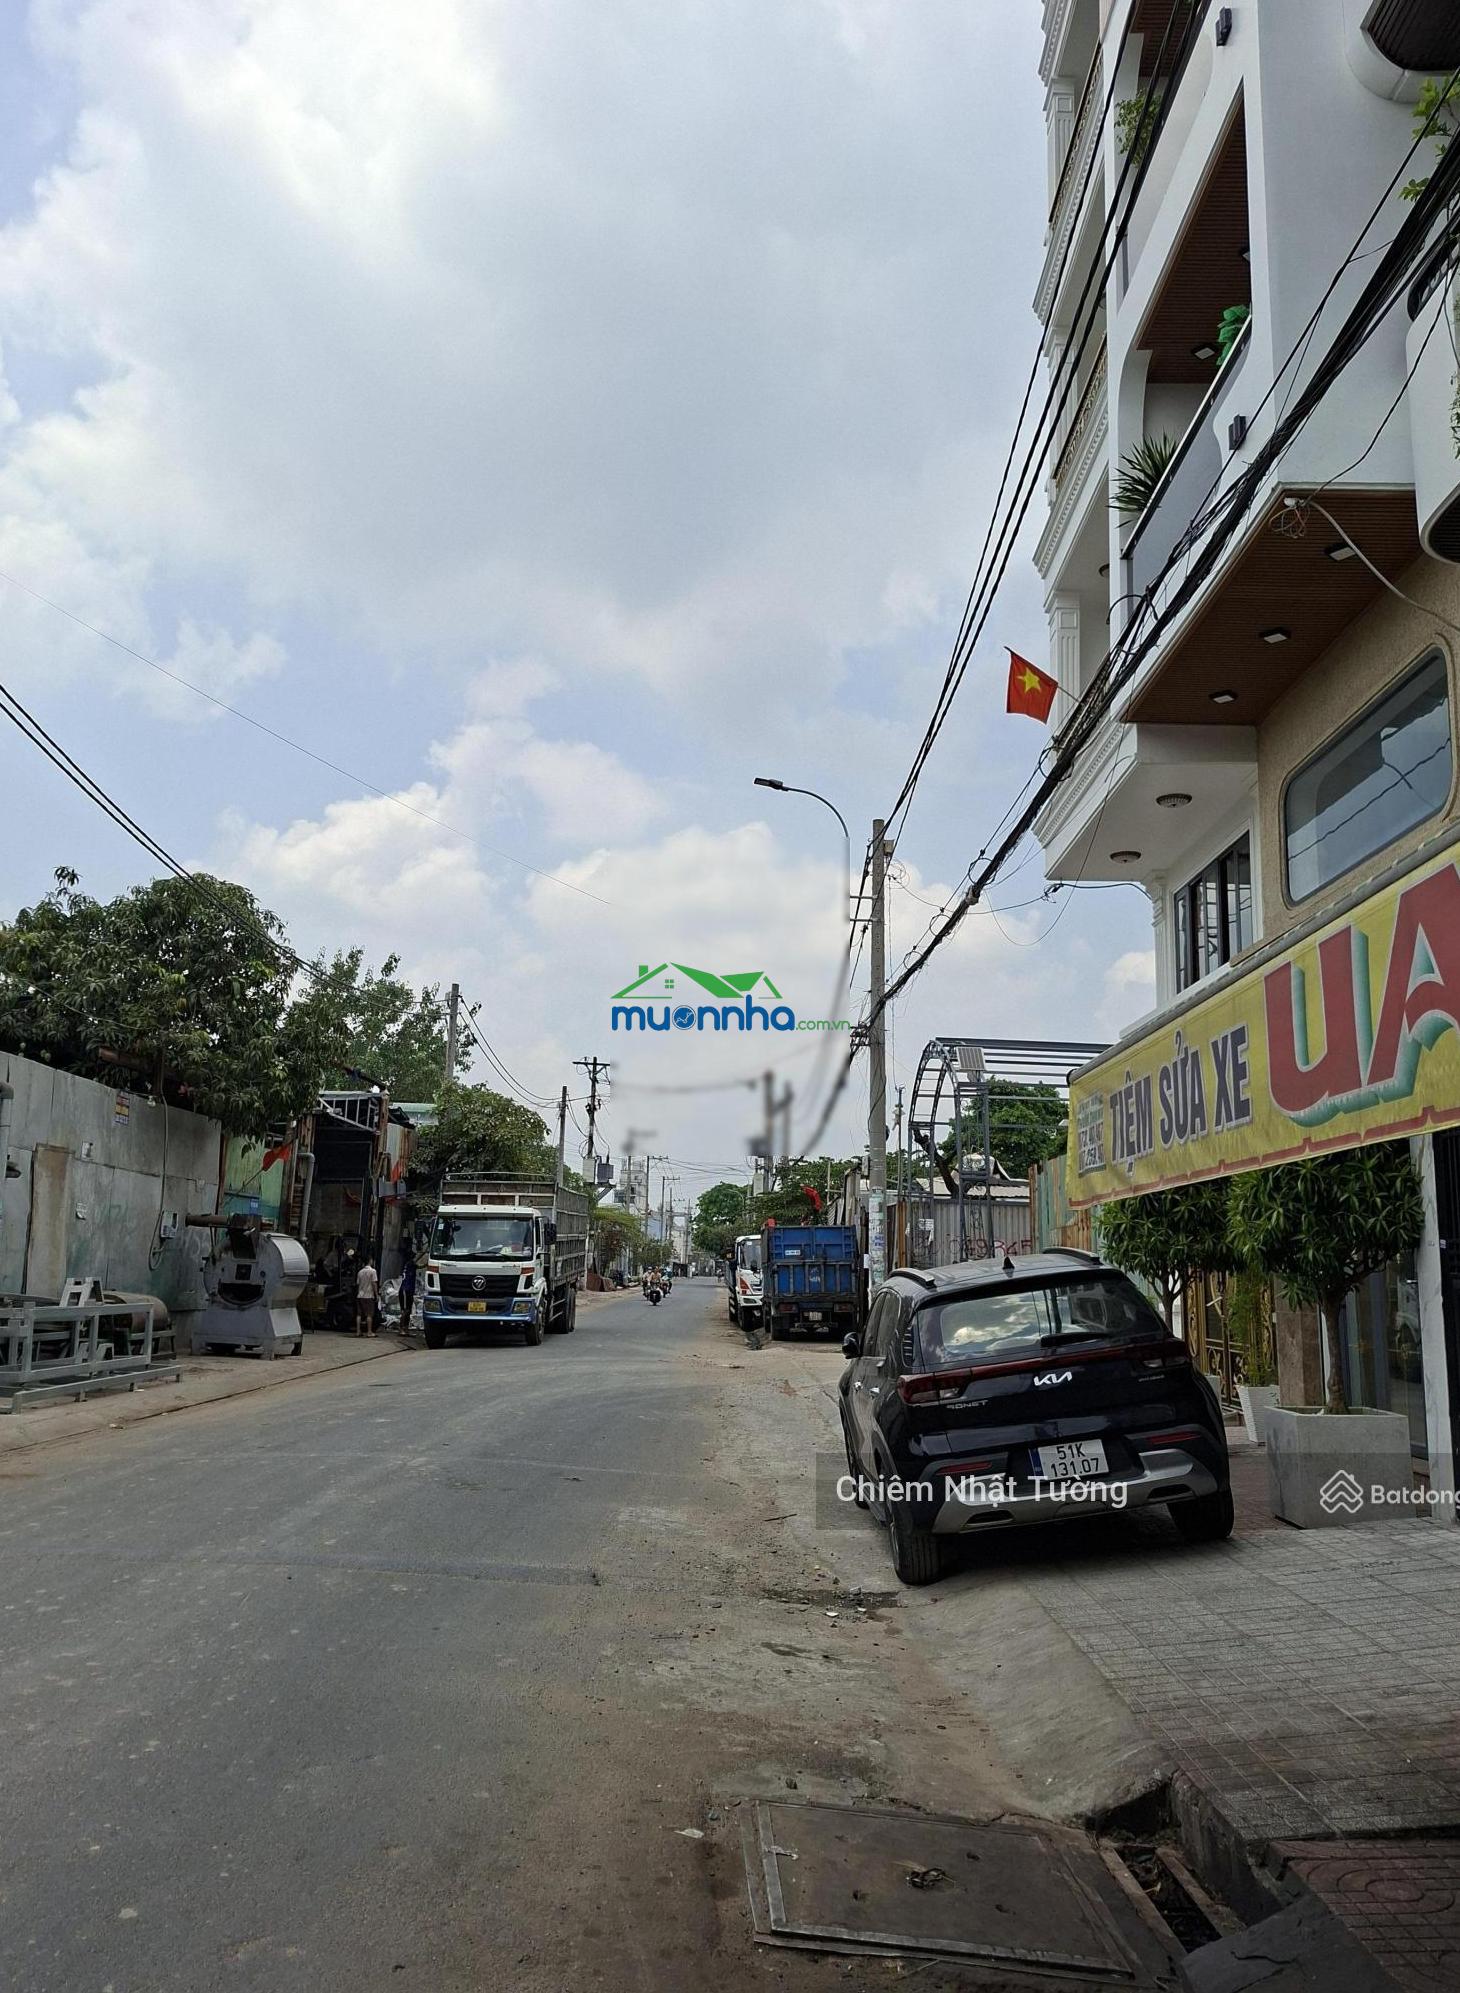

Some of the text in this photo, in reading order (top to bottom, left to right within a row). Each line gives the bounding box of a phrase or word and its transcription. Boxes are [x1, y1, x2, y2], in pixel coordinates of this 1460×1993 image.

[1109, 1069, 1154, 1174] TIỆM
[1158, 1028, 1208, 1146] SỬA
[1211, 1024, 1251, 1128] XE
[1056, 1443, 1086, 1460] 51K
[1051, 1457, 1099, 1478] 131.07
